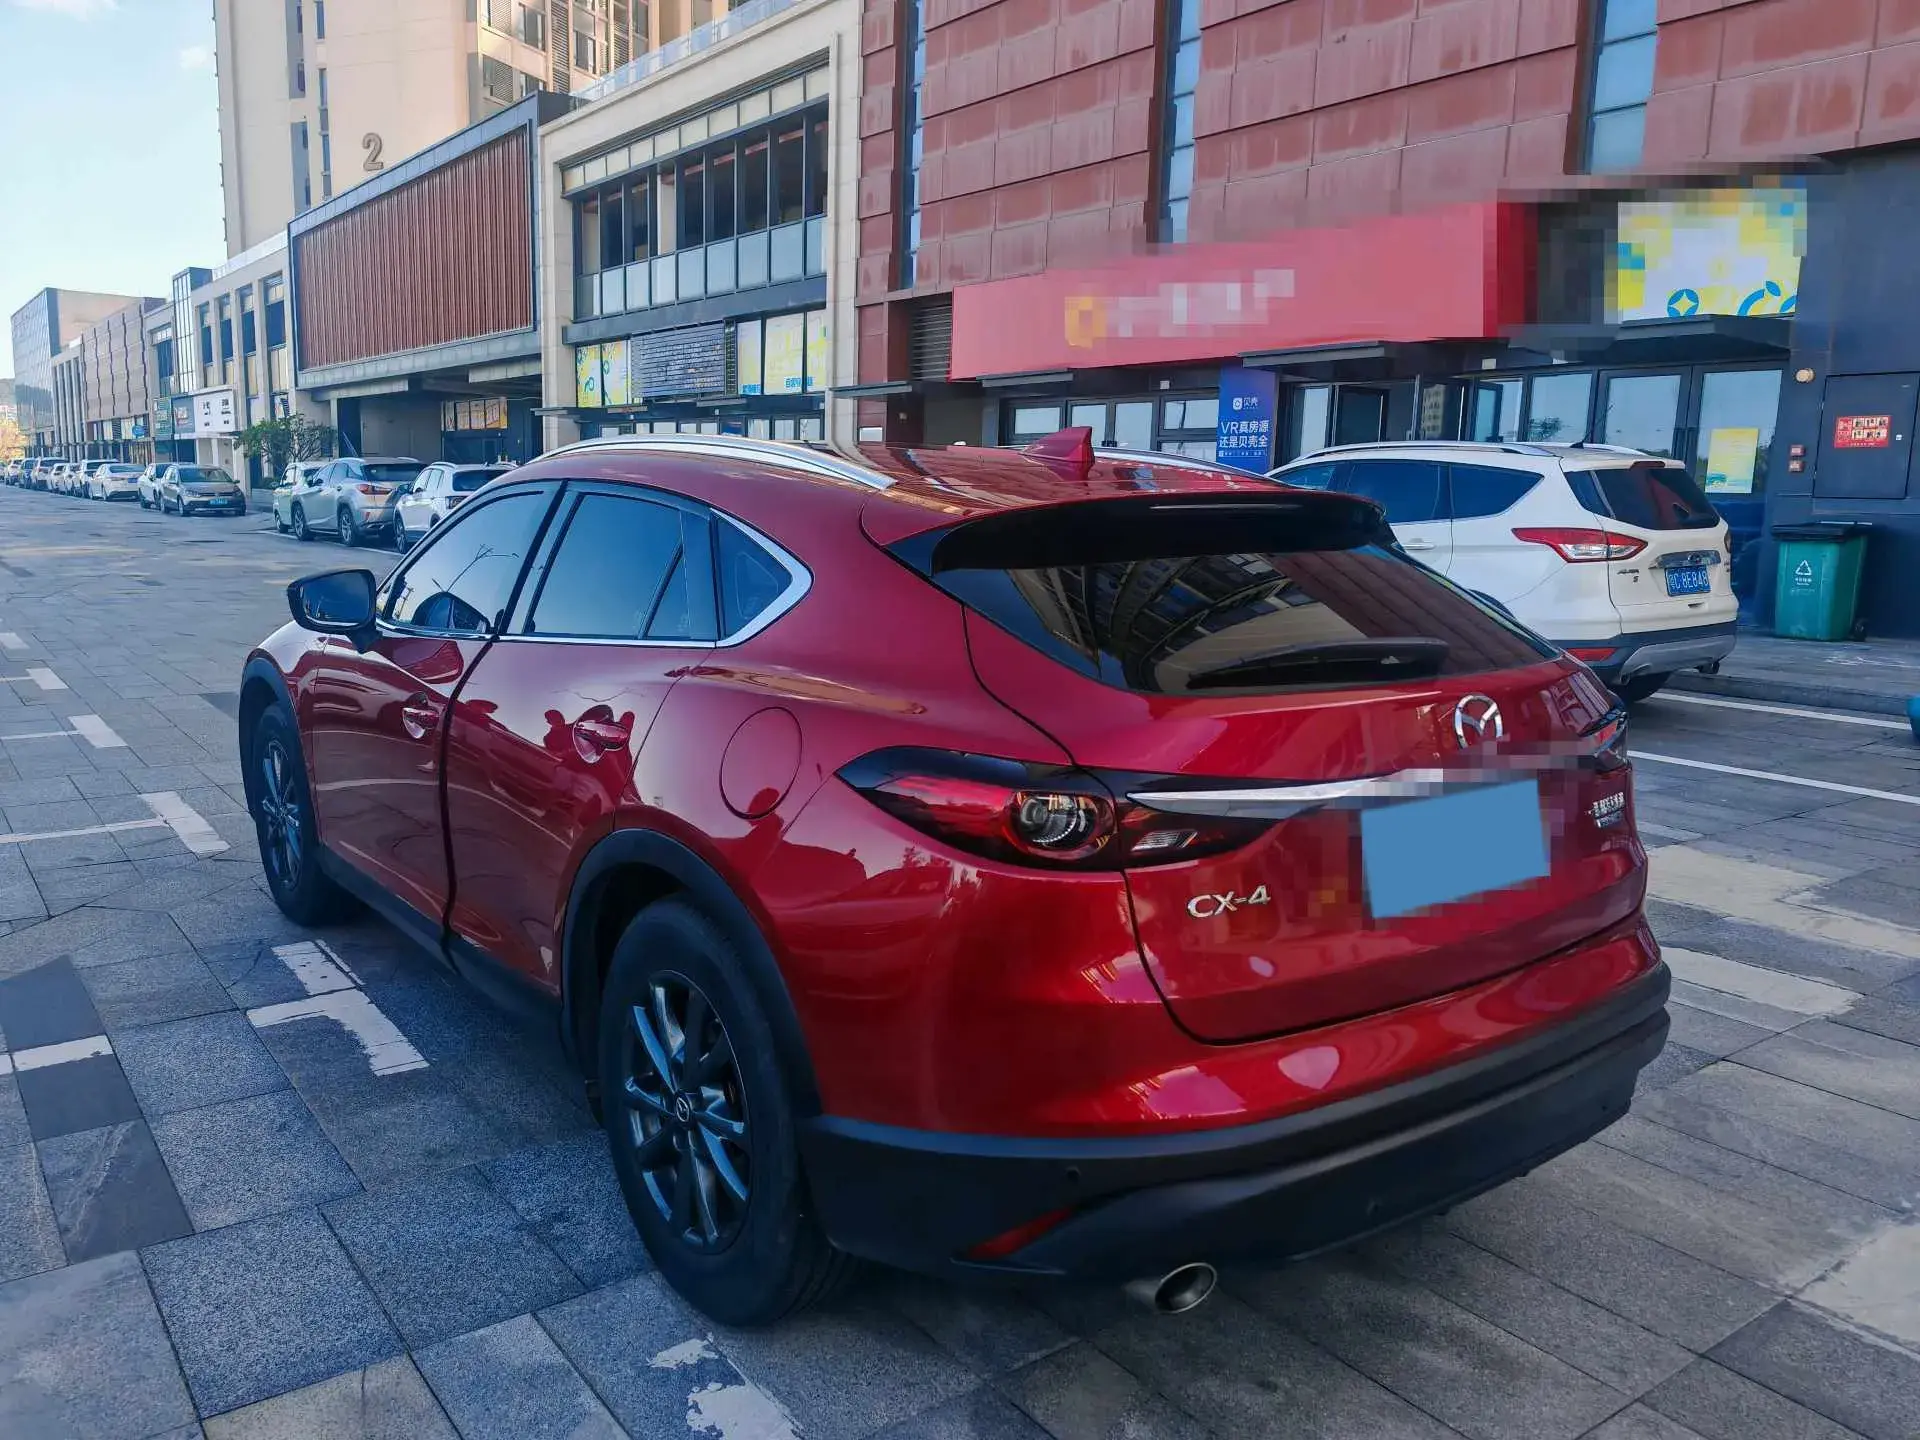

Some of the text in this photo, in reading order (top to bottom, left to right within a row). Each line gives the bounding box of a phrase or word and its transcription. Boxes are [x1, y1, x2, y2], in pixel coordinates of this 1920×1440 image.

[362, 132, 385, 172] 2
[1221, 420, 1270, 435] VR真房源
[1219, 434, 1269, 449] 还是贝壳全
[1187, 885, 1271, 918] CX-4
